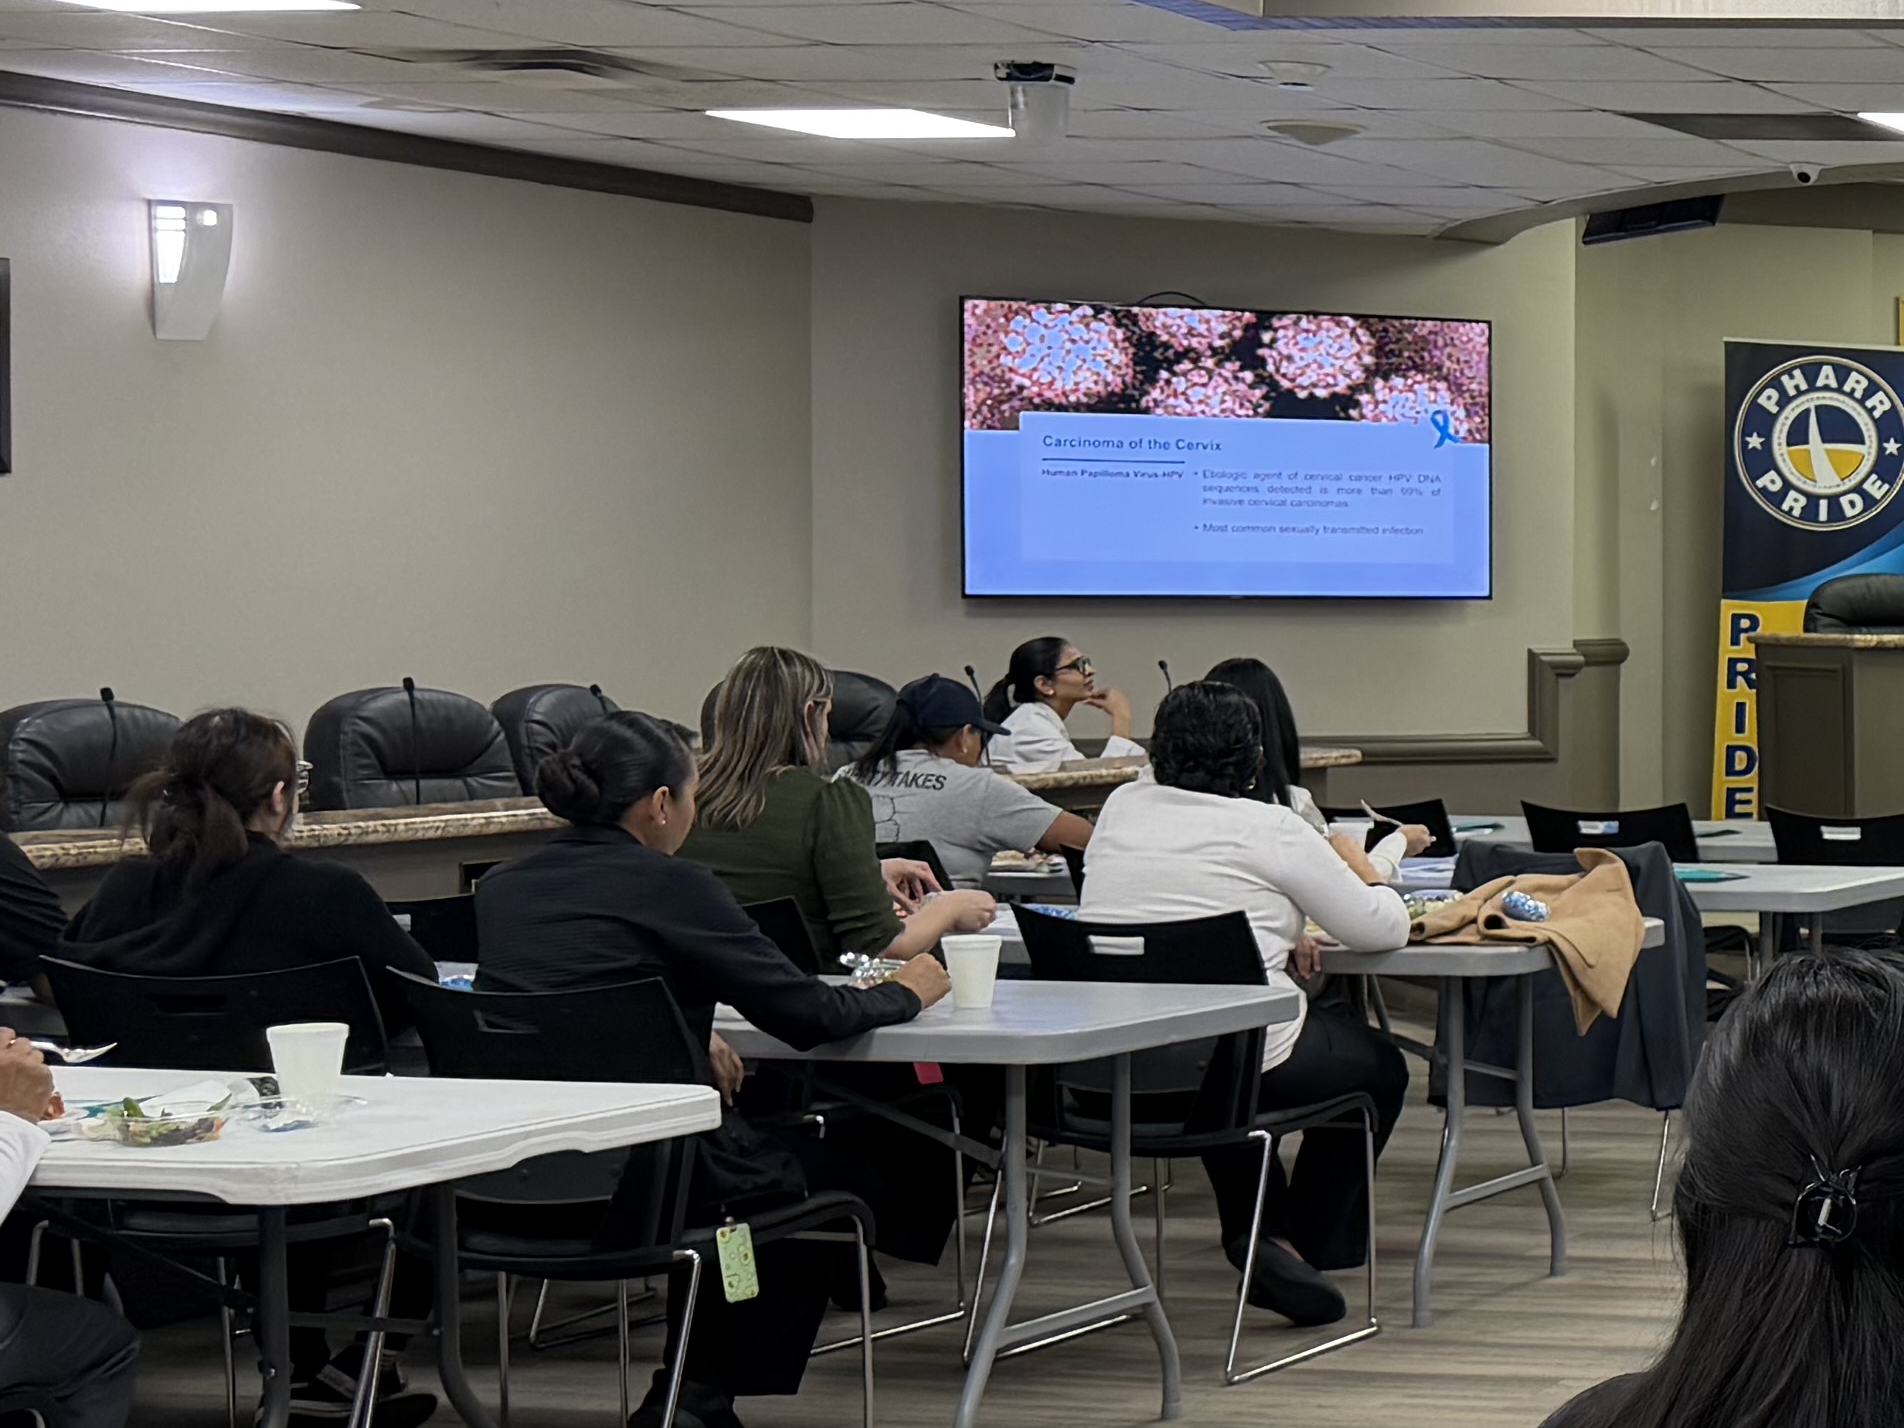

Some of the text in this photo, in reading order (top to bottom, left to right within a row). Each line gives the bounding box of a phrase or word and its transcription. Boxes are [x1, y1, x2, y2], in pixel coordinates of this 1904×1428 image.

[1756, 364, 1893, 421] PHARR
[1043, 435, 1222, 451] Carcinoma of the Cervix
[1755, 468, 1892, 523] PRIDE
